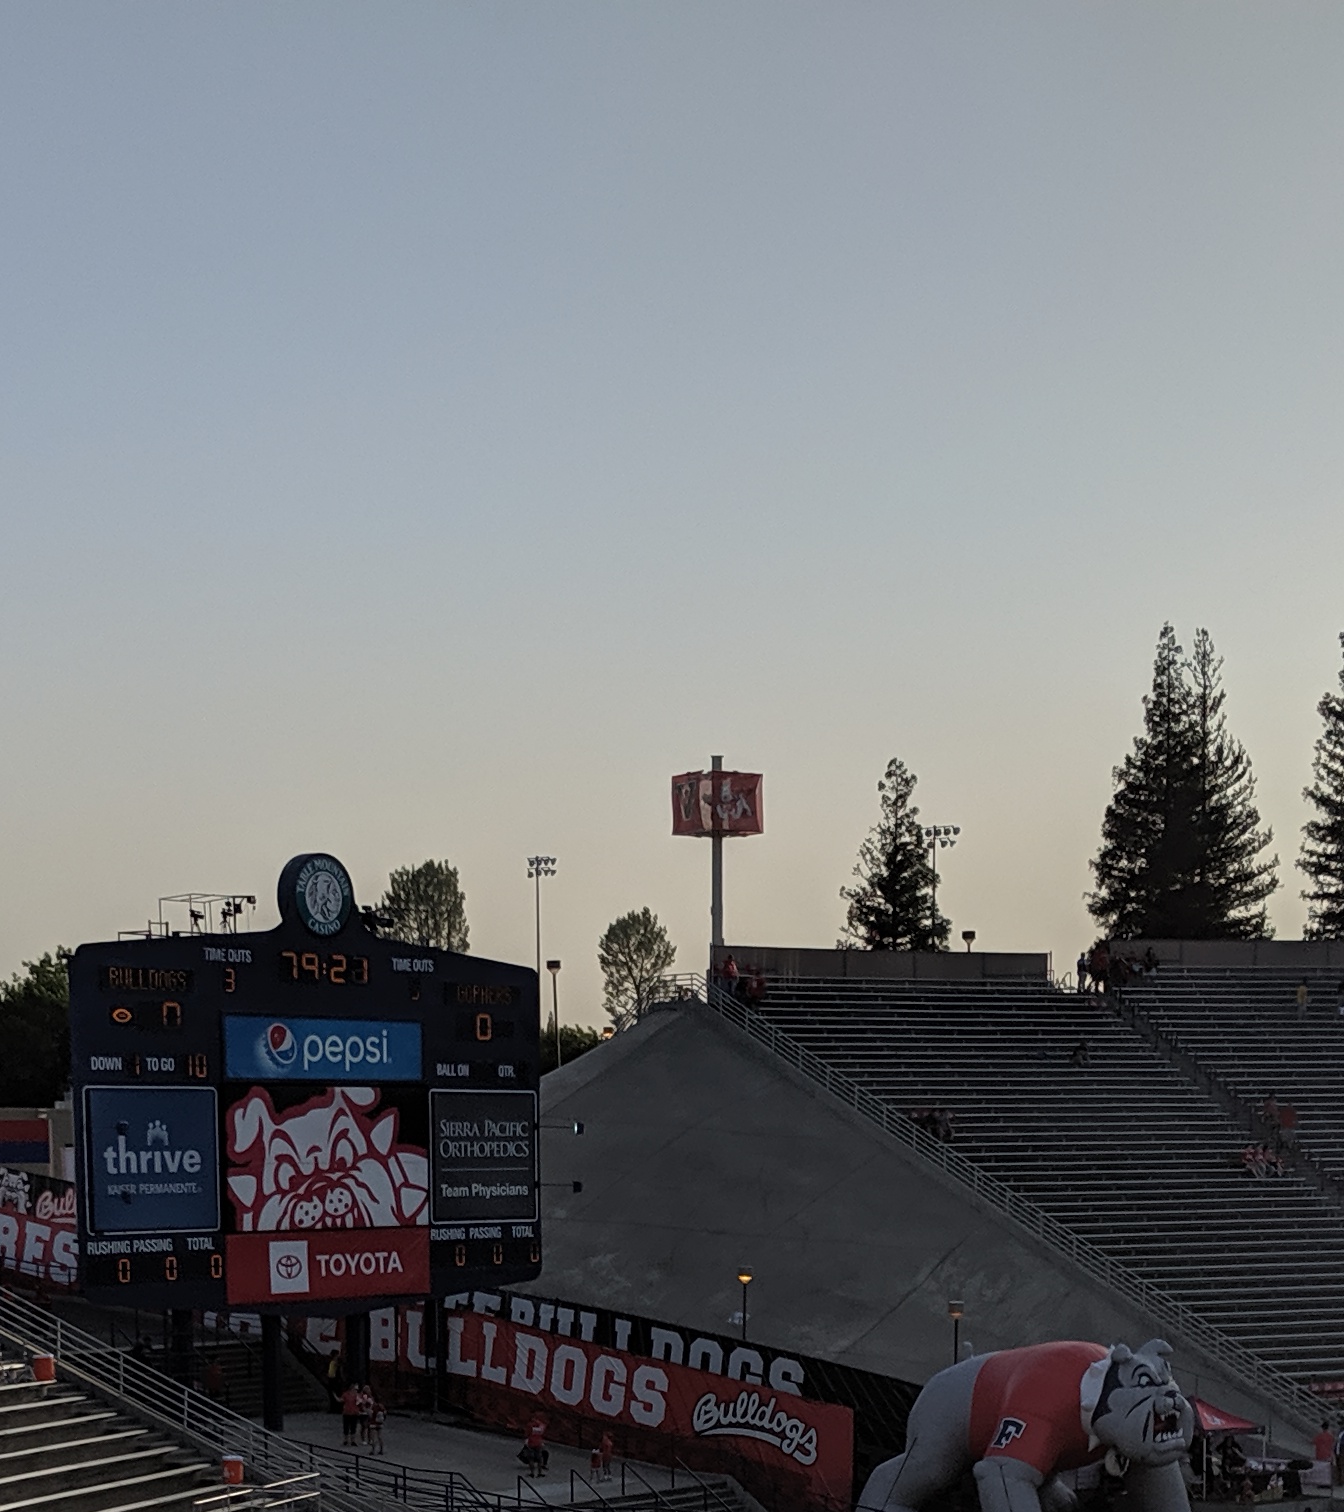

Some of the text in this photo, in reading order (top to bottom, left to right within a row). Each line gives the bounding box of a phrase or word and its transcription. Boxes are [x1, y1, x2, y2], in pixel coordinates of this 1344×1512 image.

[308, 918, 342, 936] CASINO
[203, 947, 253, 963] TIME OUTS
[392, 957, 434, 973] TIME OUTS
[224, 967, 236, 993] 3
[474, 1012, 493, 1042] 0
[303, 1029, 388, 1071] pepsi
[91, 1057, 123, 1071] DOWN
[146, 1058, 176, 1071] TO GO
[436, 1063, 469, 1076] BALL ON
[440, 1119, 529, 1138] SIERRA PACIFIC
[104, 1135, 202, 1174] thrive
[440, 1139, 529, 1158] ORTHOPEDICS
[441, 1183, 529, 1199] Team Physicians
[430, 1226, 534, 1241] RUSHING PASSING TOTAL
[87, 1237, 215, 1255] RUSHING PASSING TOTAL
[118, 1254, 223, 1283] 0 0 0
[316, 1251, 404, 1277] TOYOTA
[692, 1391, 818, 1466] Bulldogs
[992, 1417, 1027, 1449] F
